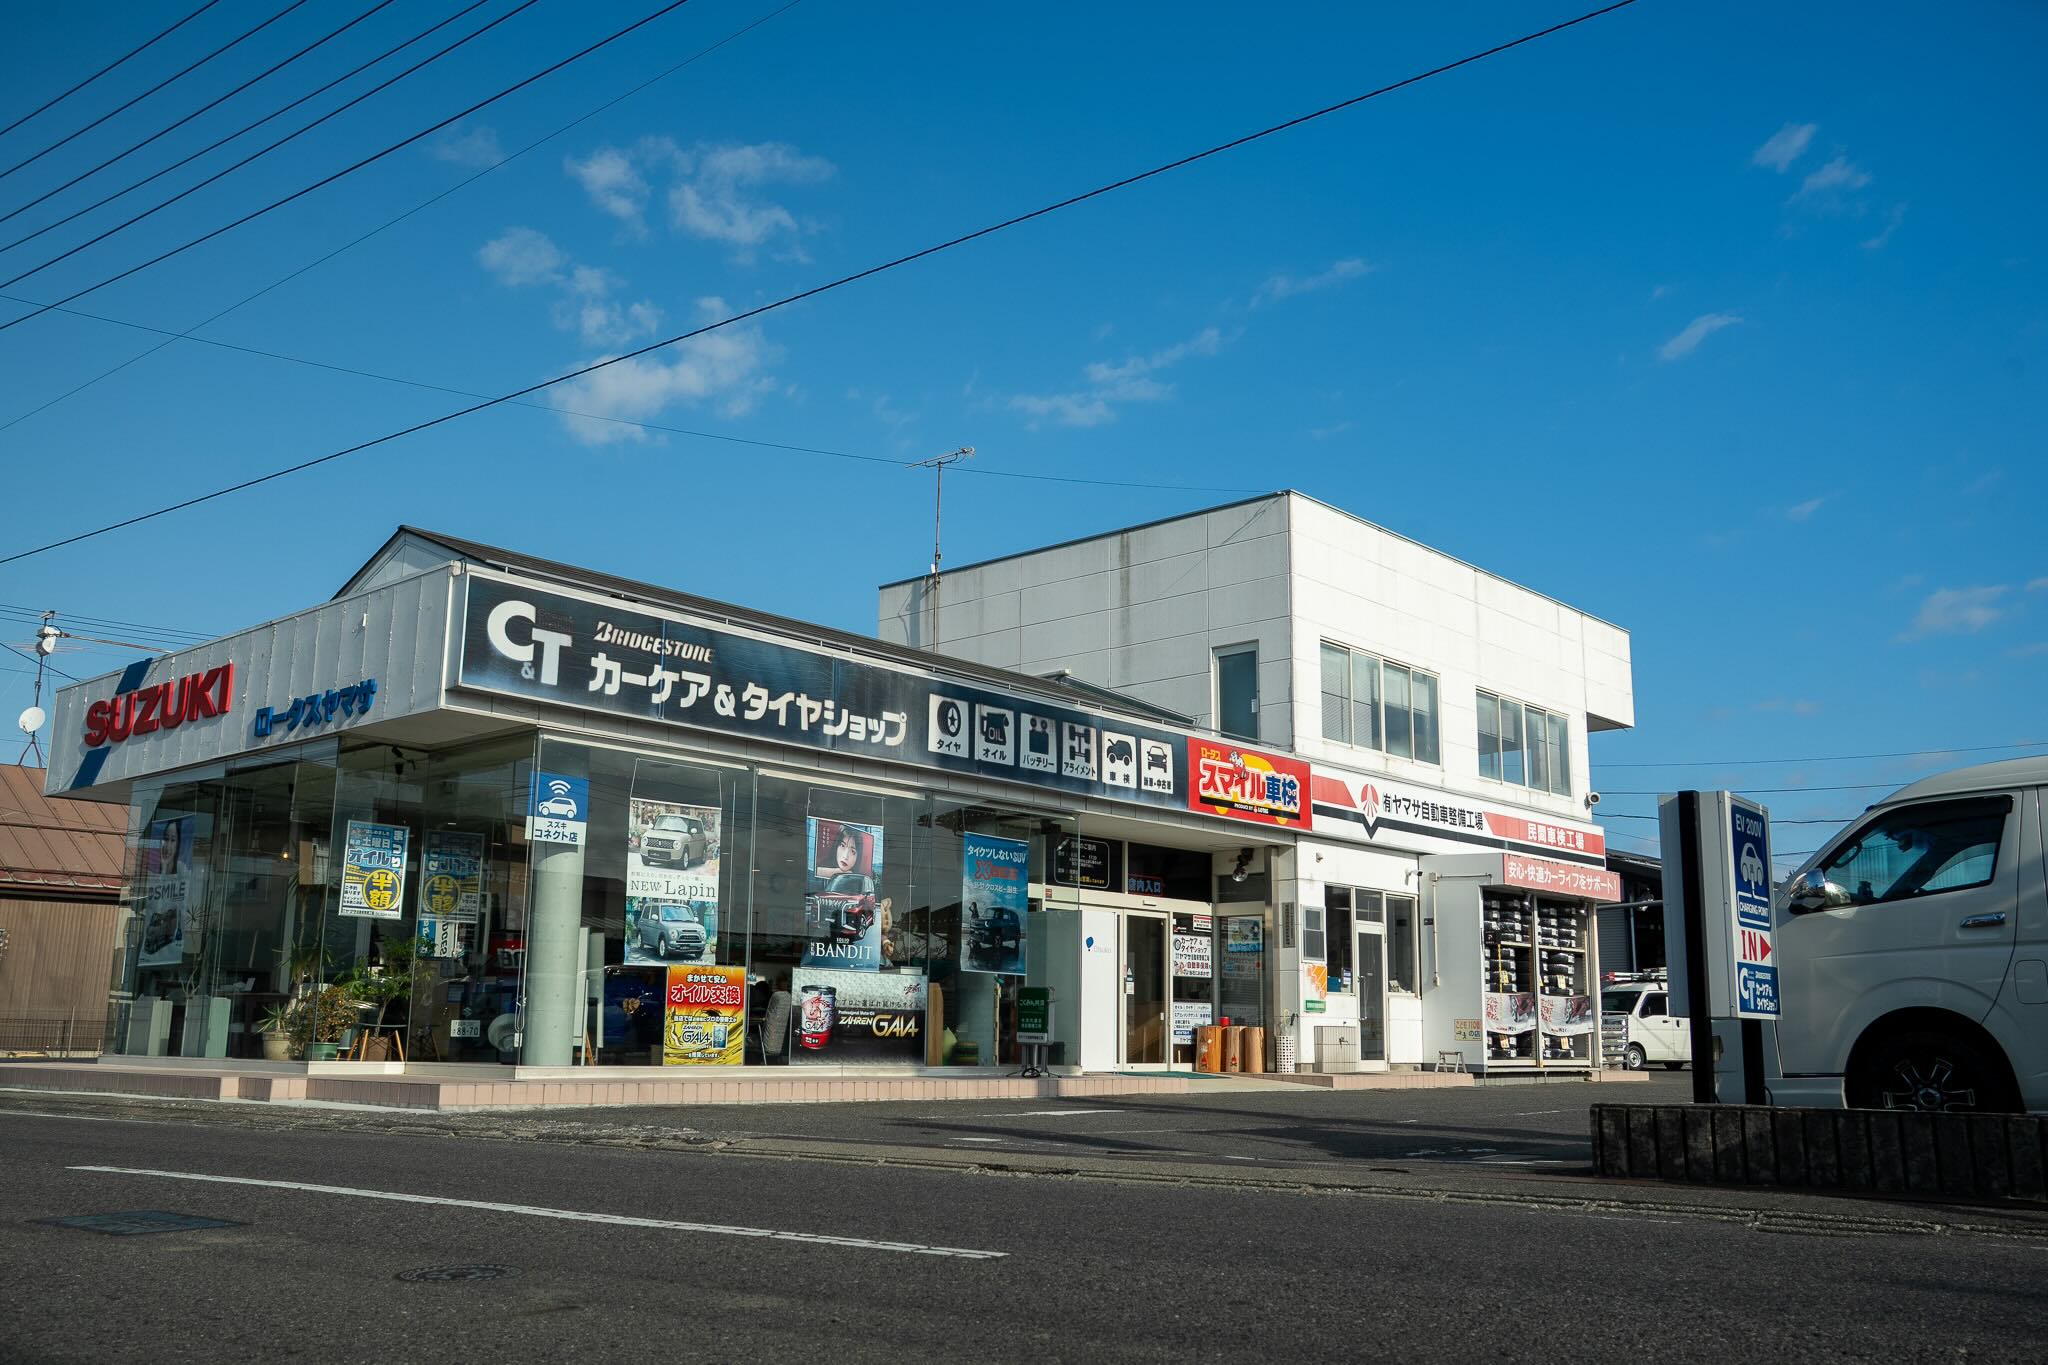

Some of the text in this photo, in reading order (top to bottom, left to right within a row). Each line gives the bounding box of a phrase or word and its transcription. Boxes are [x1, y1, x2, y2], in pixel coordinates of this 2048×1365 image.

[594, 622, 713, 664] BRIDGESTONE
[85, 663, 234, 747] SUZUKI
[254, 679, 378, 737] ロータスヤマサ
[988, 727, 1005, 741] OIL
[936, 739, 961, 753] タイヤ
[982, 748, 1007, 761] オイル
[1201, 747, 1221, 761] ロータス
[1023, 754, 1055, 768] バッテリー
[1063, 762, 1096, 777] アライメント
[1200, 760, 1299, 808] スマイル車検
[547, 821, 567, 829] スズキ
[1736, 814, 1762, 838] EV 200V
[534, 828, 578, 843] コネクト店
[1527, 822, 1584, 850] 民間車検工場
[348, 848, 391, 866] オイル
[369, 872, 394, 910] 半額
[631, 880, 716, 900] NEW Lapin
[815, 942, 872, 960] BANDIT
[1741, 929, 1758, 962] IN
[687, 974, 727, 984] まかせて安心
[671, 984, 740, 1005] オイル交換
